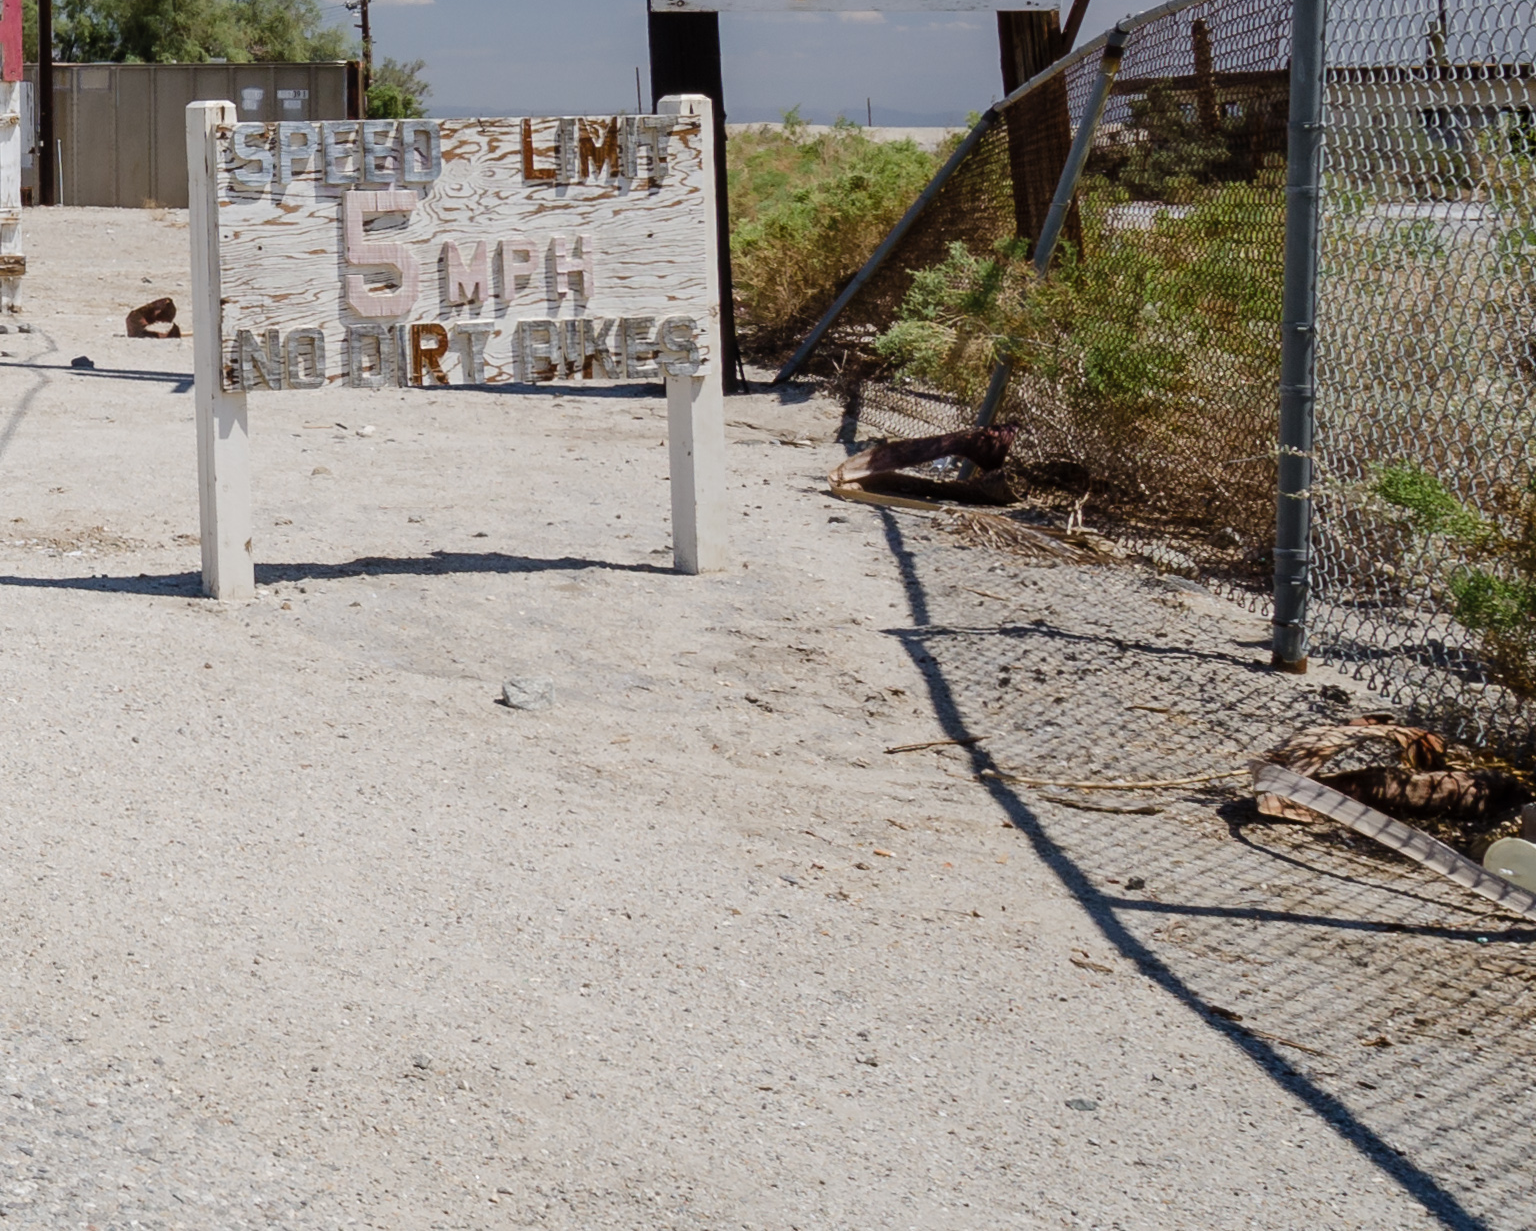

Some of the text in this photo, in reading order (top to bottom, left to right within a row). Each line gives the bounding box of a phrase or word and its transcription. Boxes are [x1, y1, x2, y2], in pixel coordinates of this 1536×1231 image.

[233, 116, 677, 186] SPEED LIMIT
[342, 190, 595, 317] 5 MPH
[236, 315, 701, 391] NO DIRT BIKES
